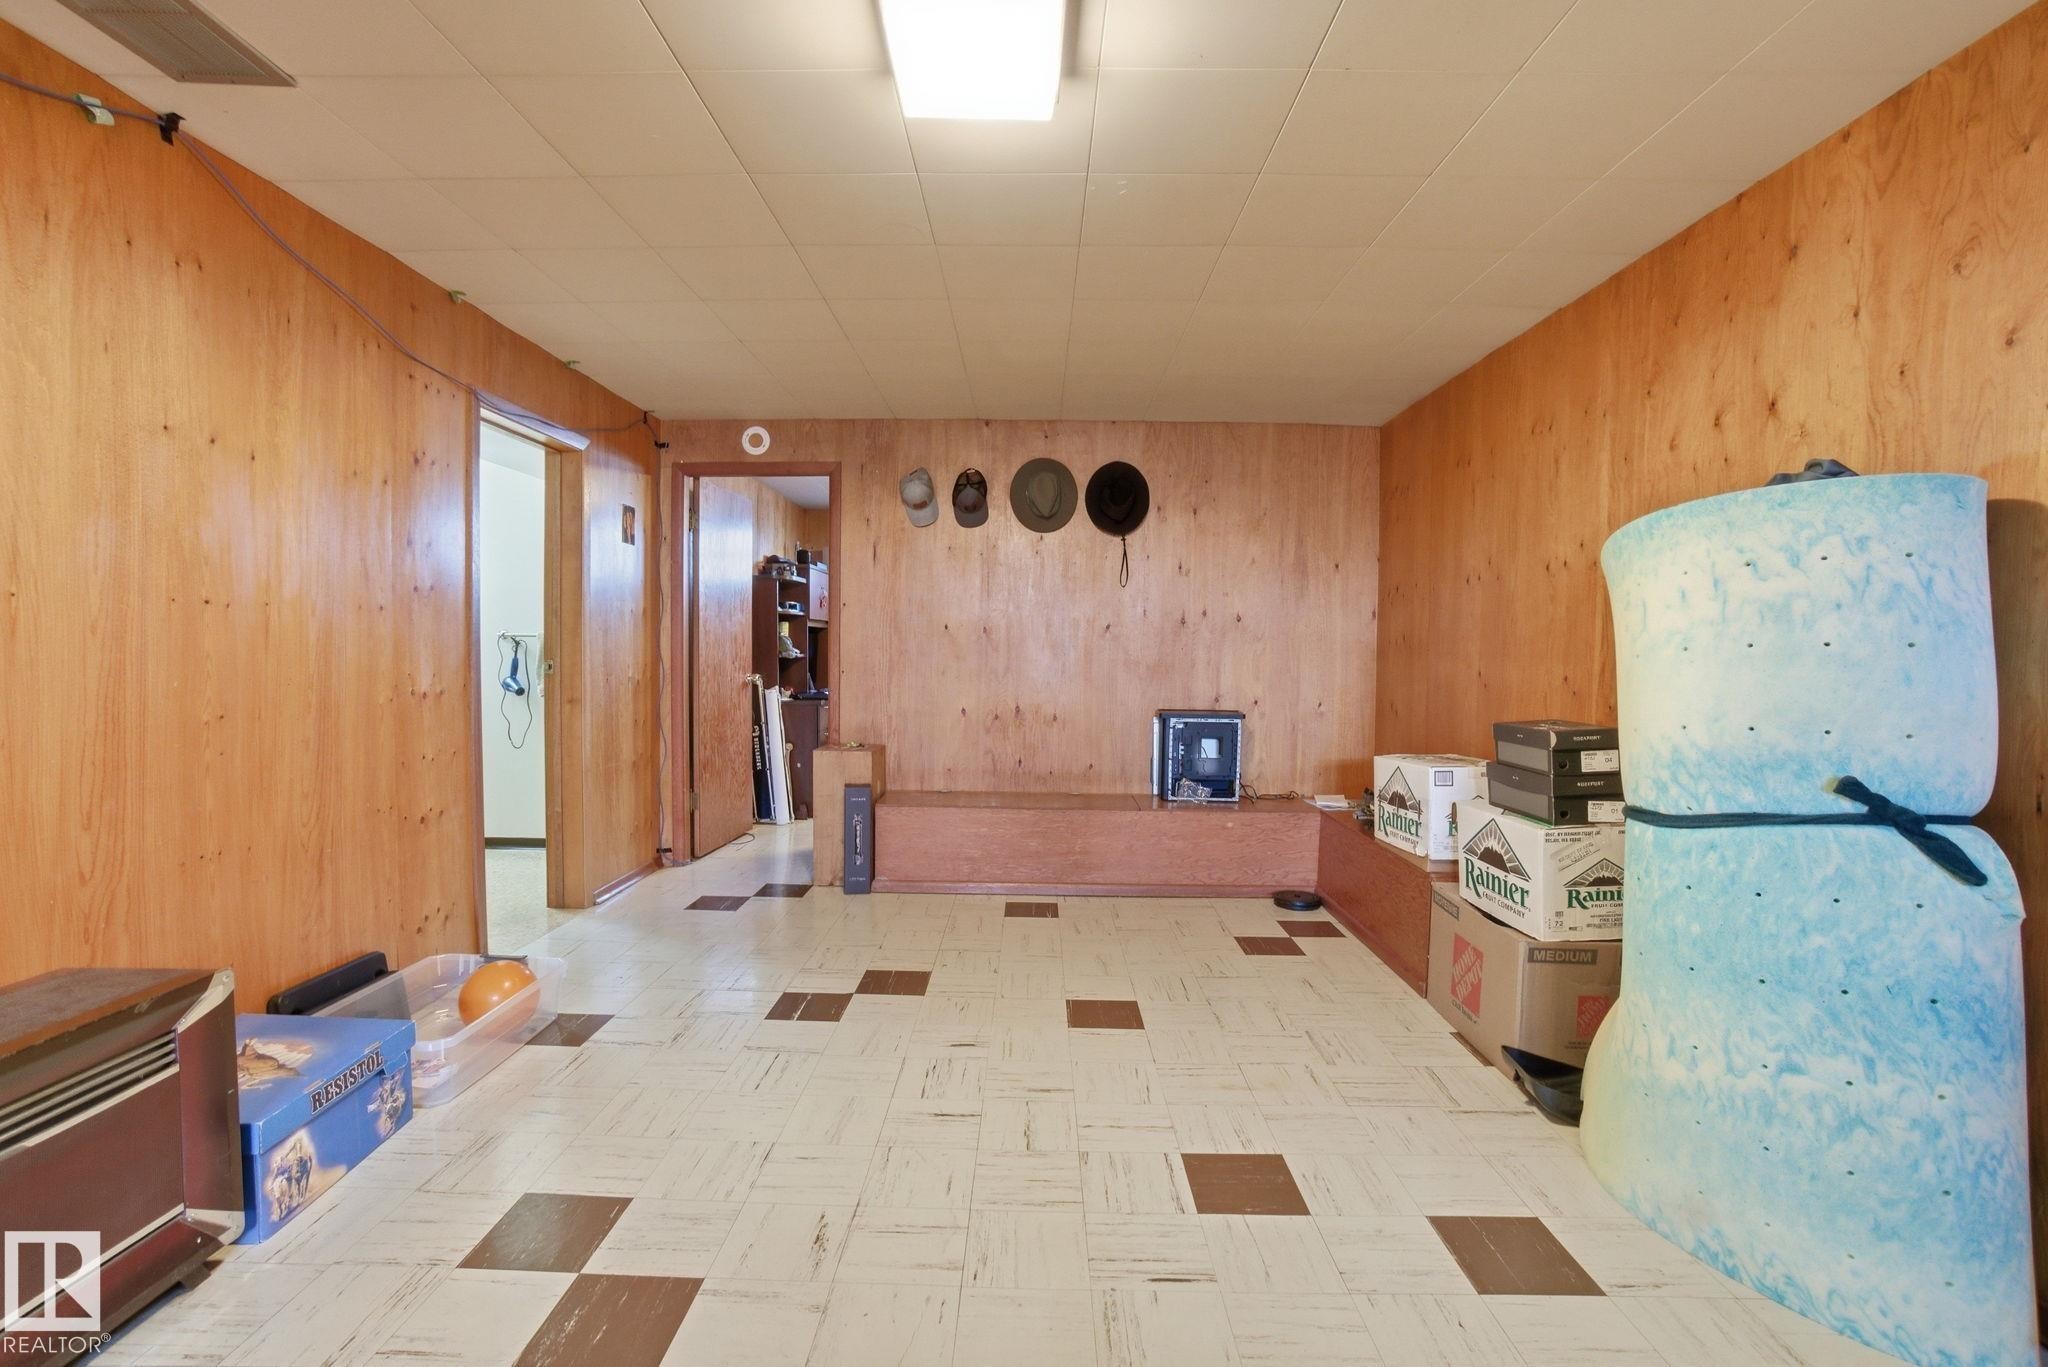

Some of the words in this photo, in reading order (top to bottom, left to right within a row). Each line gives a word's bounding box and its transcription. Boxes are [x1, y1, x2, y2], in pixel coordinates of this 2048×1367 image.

[1378, 803, 1422, 838] Rainier
[1464, 856, 1529, 909] Rainier
[1497, 899, 1526, 919] COMPANY
[1566, 886, 1624, 910] Raini
[1533, 950, 1591, 962] MEDIUM
[310, 1048, 384, 1115] RESISTOL
